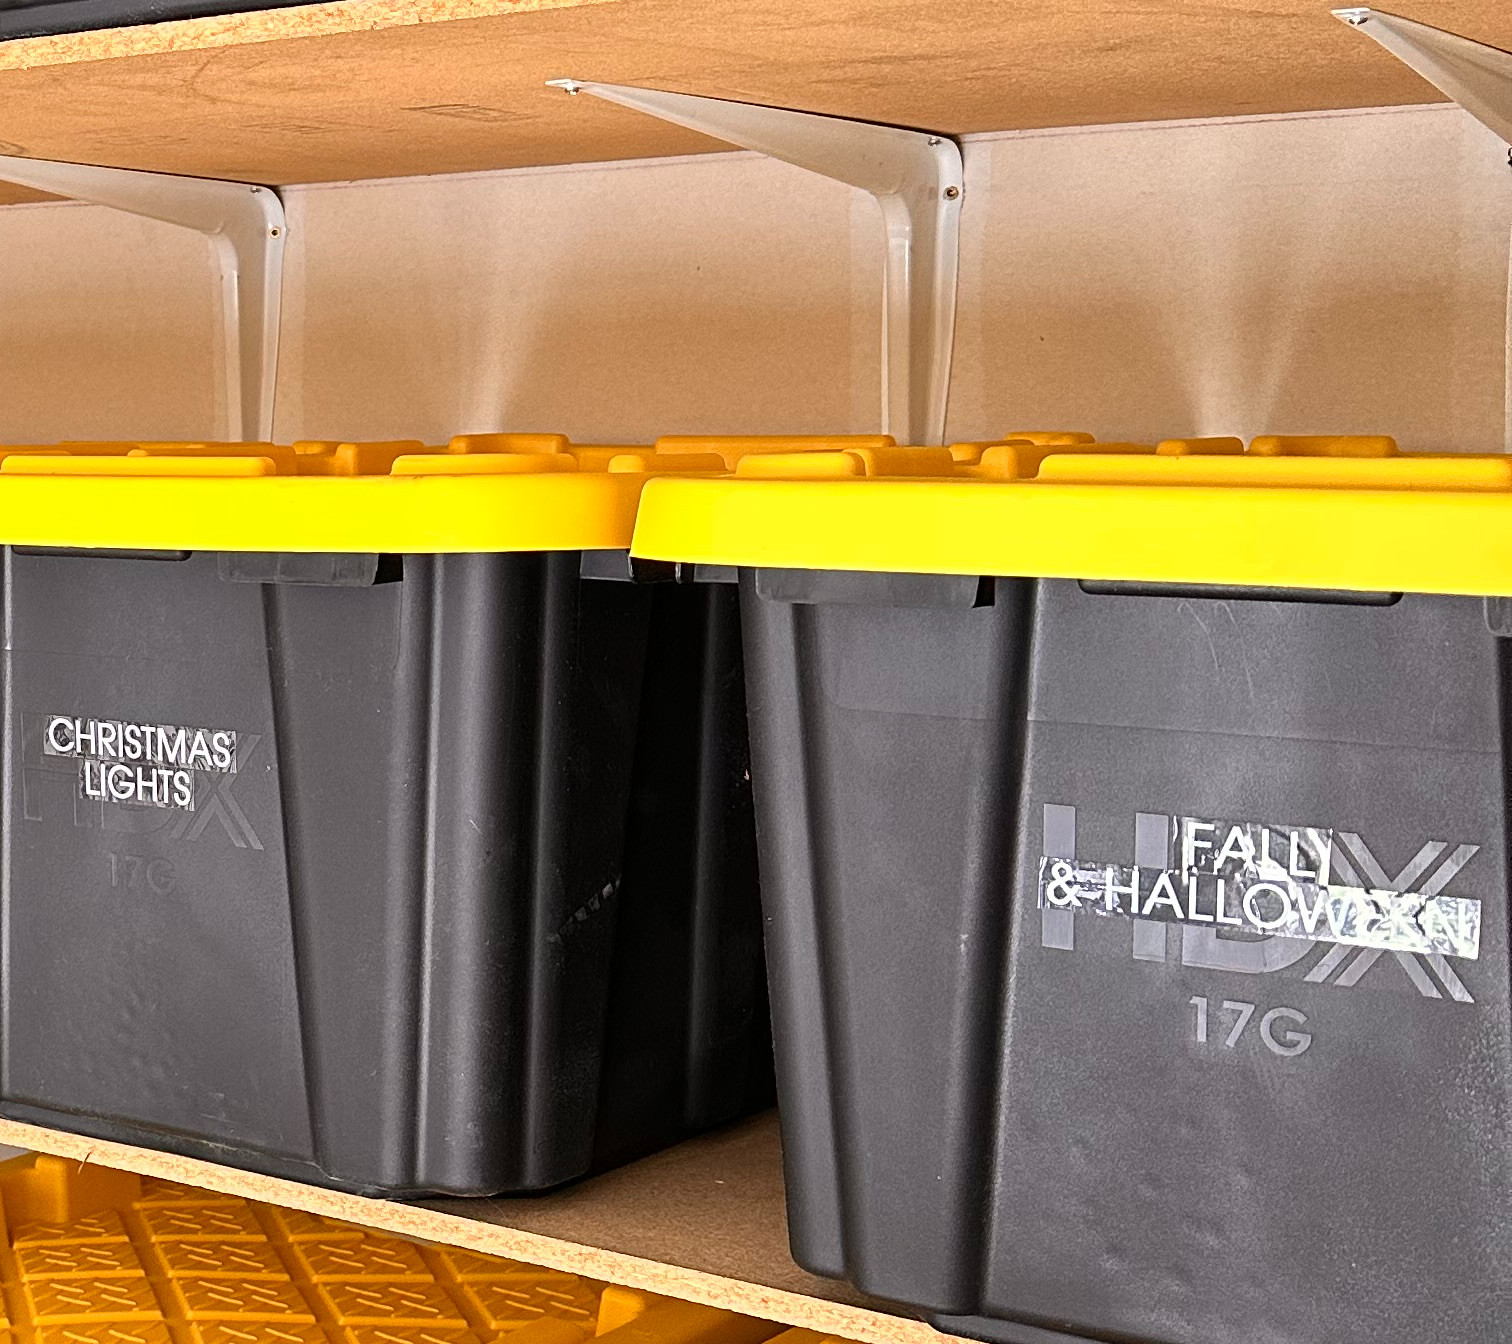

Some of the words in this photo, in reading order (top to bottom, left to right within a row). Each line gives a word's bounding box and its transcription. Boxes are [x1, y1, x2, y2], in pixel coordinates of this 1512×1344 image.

[48, 717, 232, 769] CHRISTMAS
[84, 761, 191, 807] LIGHTS
[1188, 822, 1317, 879] FALL
[1046, 861, 1082, 909] &
[1188, 995, 1313, 1058] 17G
